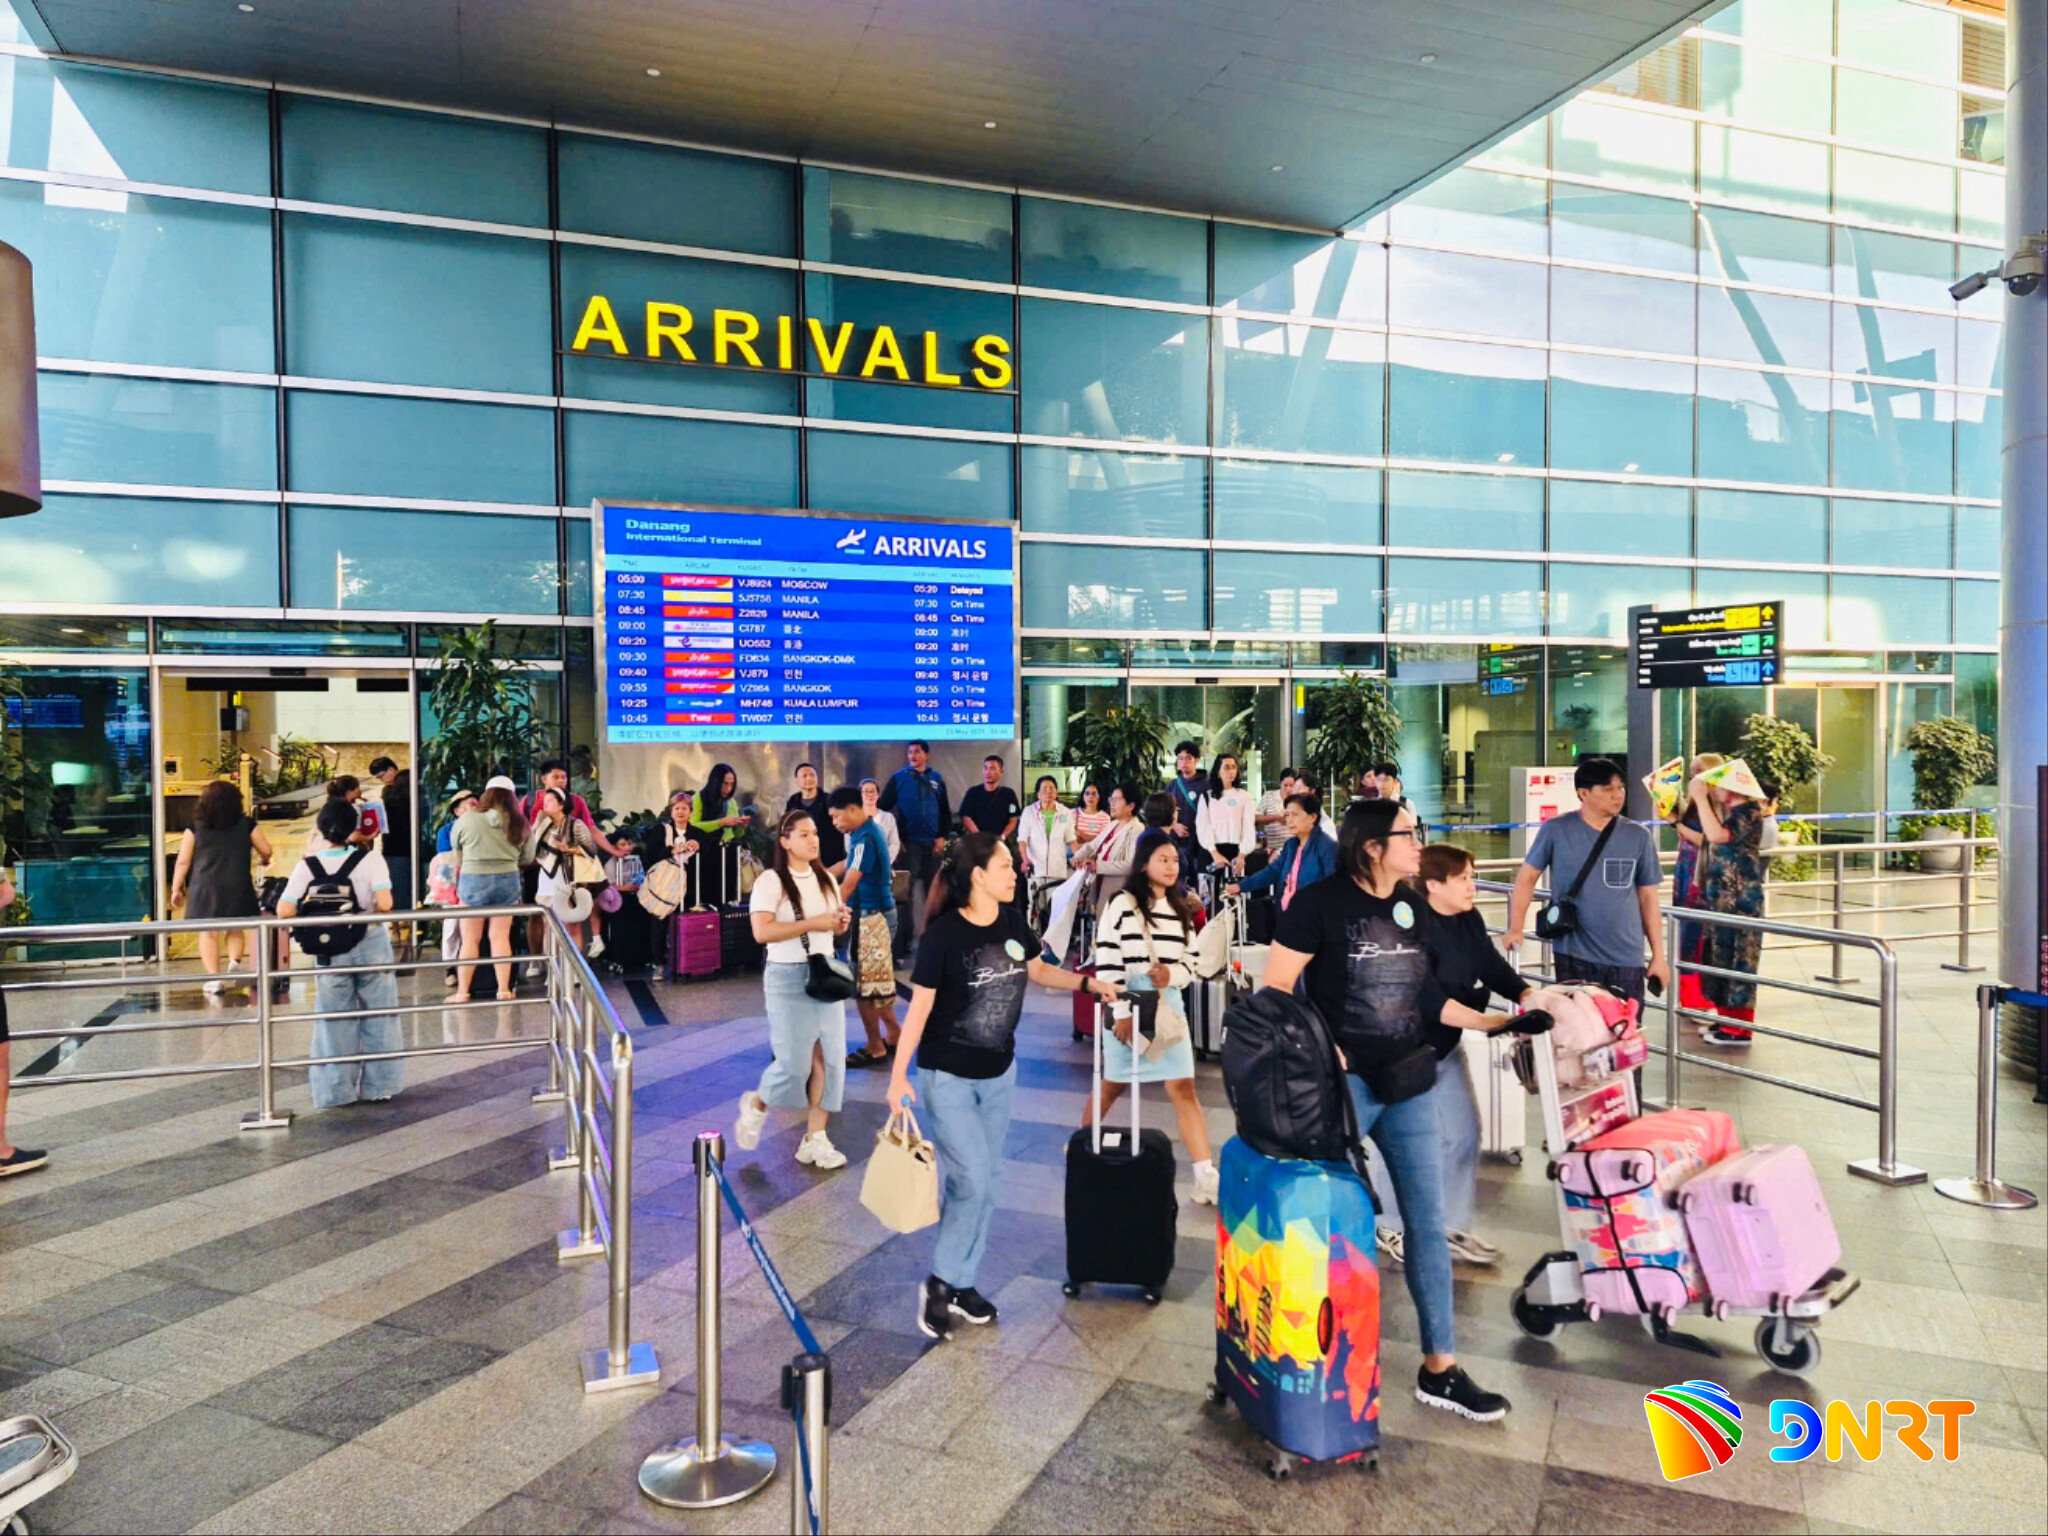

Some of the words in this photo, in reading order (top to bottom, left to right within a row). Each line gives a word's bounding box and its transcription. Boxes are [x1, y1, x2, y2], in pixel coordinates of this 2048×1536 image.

[572, 295, 1012, 388] ARRIVALS
[625, 519, 690, 534] Danang
[625, 532, 707, 544] International
[709, 536, 762, 547] Terminal
[873, 535, 987, 560] ARRIVALS
[618, 574, 645, 583] 05:00
[781, 578, 829, 590] MOSCOW
[618, 590, 645, 599] 07:30
[951, 586, 983, 595] Delayed
[782, 596, 819, 604] MANILA
[914, 599, 938, 607] 07:30
[618, 606, 645, 614] 08:45
[783, 610, 819, 619] MANILA
[618, 621, 646, 629] 09:00
[619, 637, 646, 645] 09:20
[619, 652, 646, 661] 09:30
[783, 655, 855, 663] BANGKOK-DMK
[951, 657, 963, 665] On
[966, 657, 984, 665] Time
[619, 668, 647, 676] 09:40
[620, 683, 647, 692] 09:55
[951, 685, 964, 693] On
[966, 685, 985, 693] Time
[621, 699, 647, 707] 10:25
[817, 699, 858, 707] LUMPUR
[966, 699, 985, 707] Time
[622, 715, 647, 723] 10:45
[916, 713, 939, 722] 10:45
